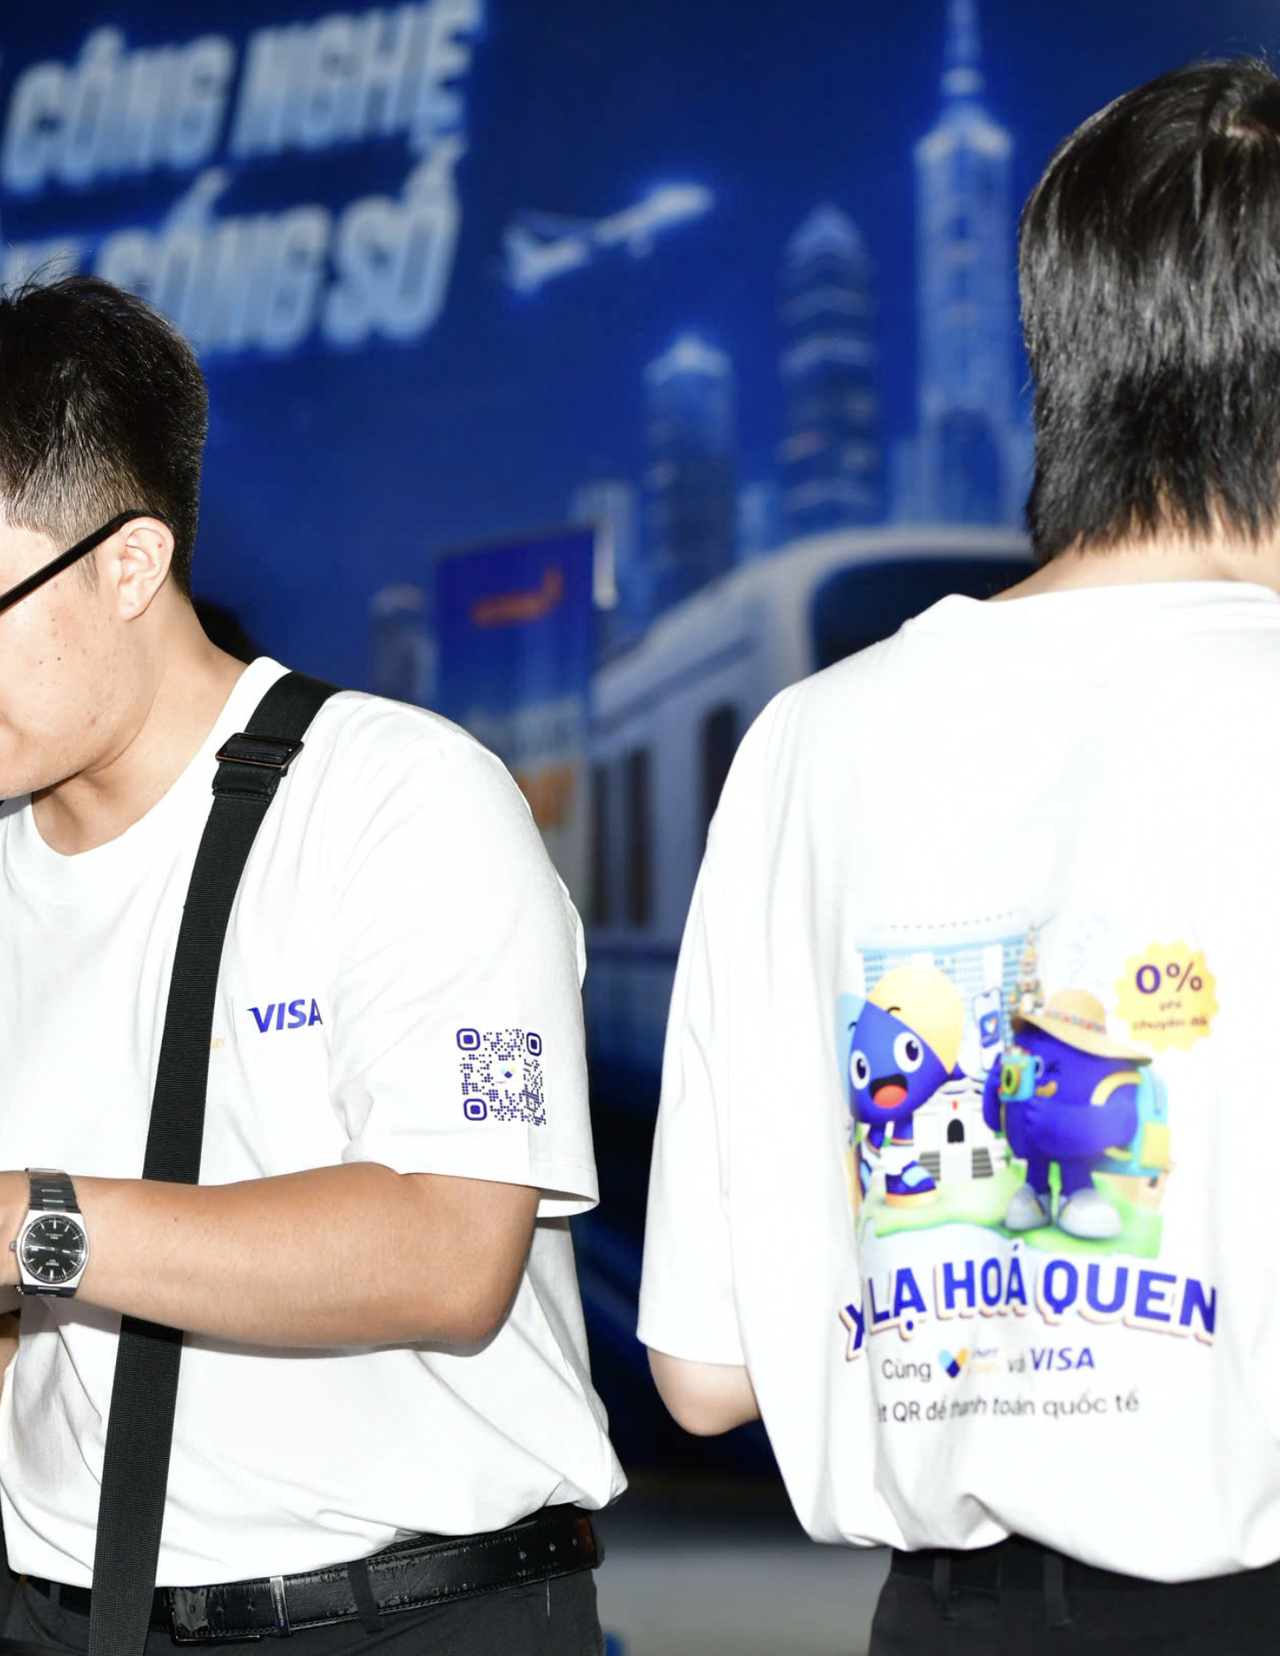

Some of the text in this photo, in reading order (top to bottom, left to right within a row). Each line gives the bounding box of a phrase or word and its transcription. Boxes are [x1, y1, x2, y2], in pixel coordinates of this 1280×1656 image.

[0, 26, 234, 190] CÔNG
[1135, 960, 1204, 995] 0%
[246, 997, 324, 1033] VISA
[867, 1265, 929, 1332] LẠ
[942, 1242, 1028, 1311] HOÁ
[1042, 1258, 1218, 1336] QUEN
[881, 1356, 933, 1383] Cùng
[1029, 1346, 1095, 1372] VISA
[892, 1400, 921, 1423] QR
[1042, 1387, 1108, 1420] quốc
[1115, 1385, 1140, 1413] tế
